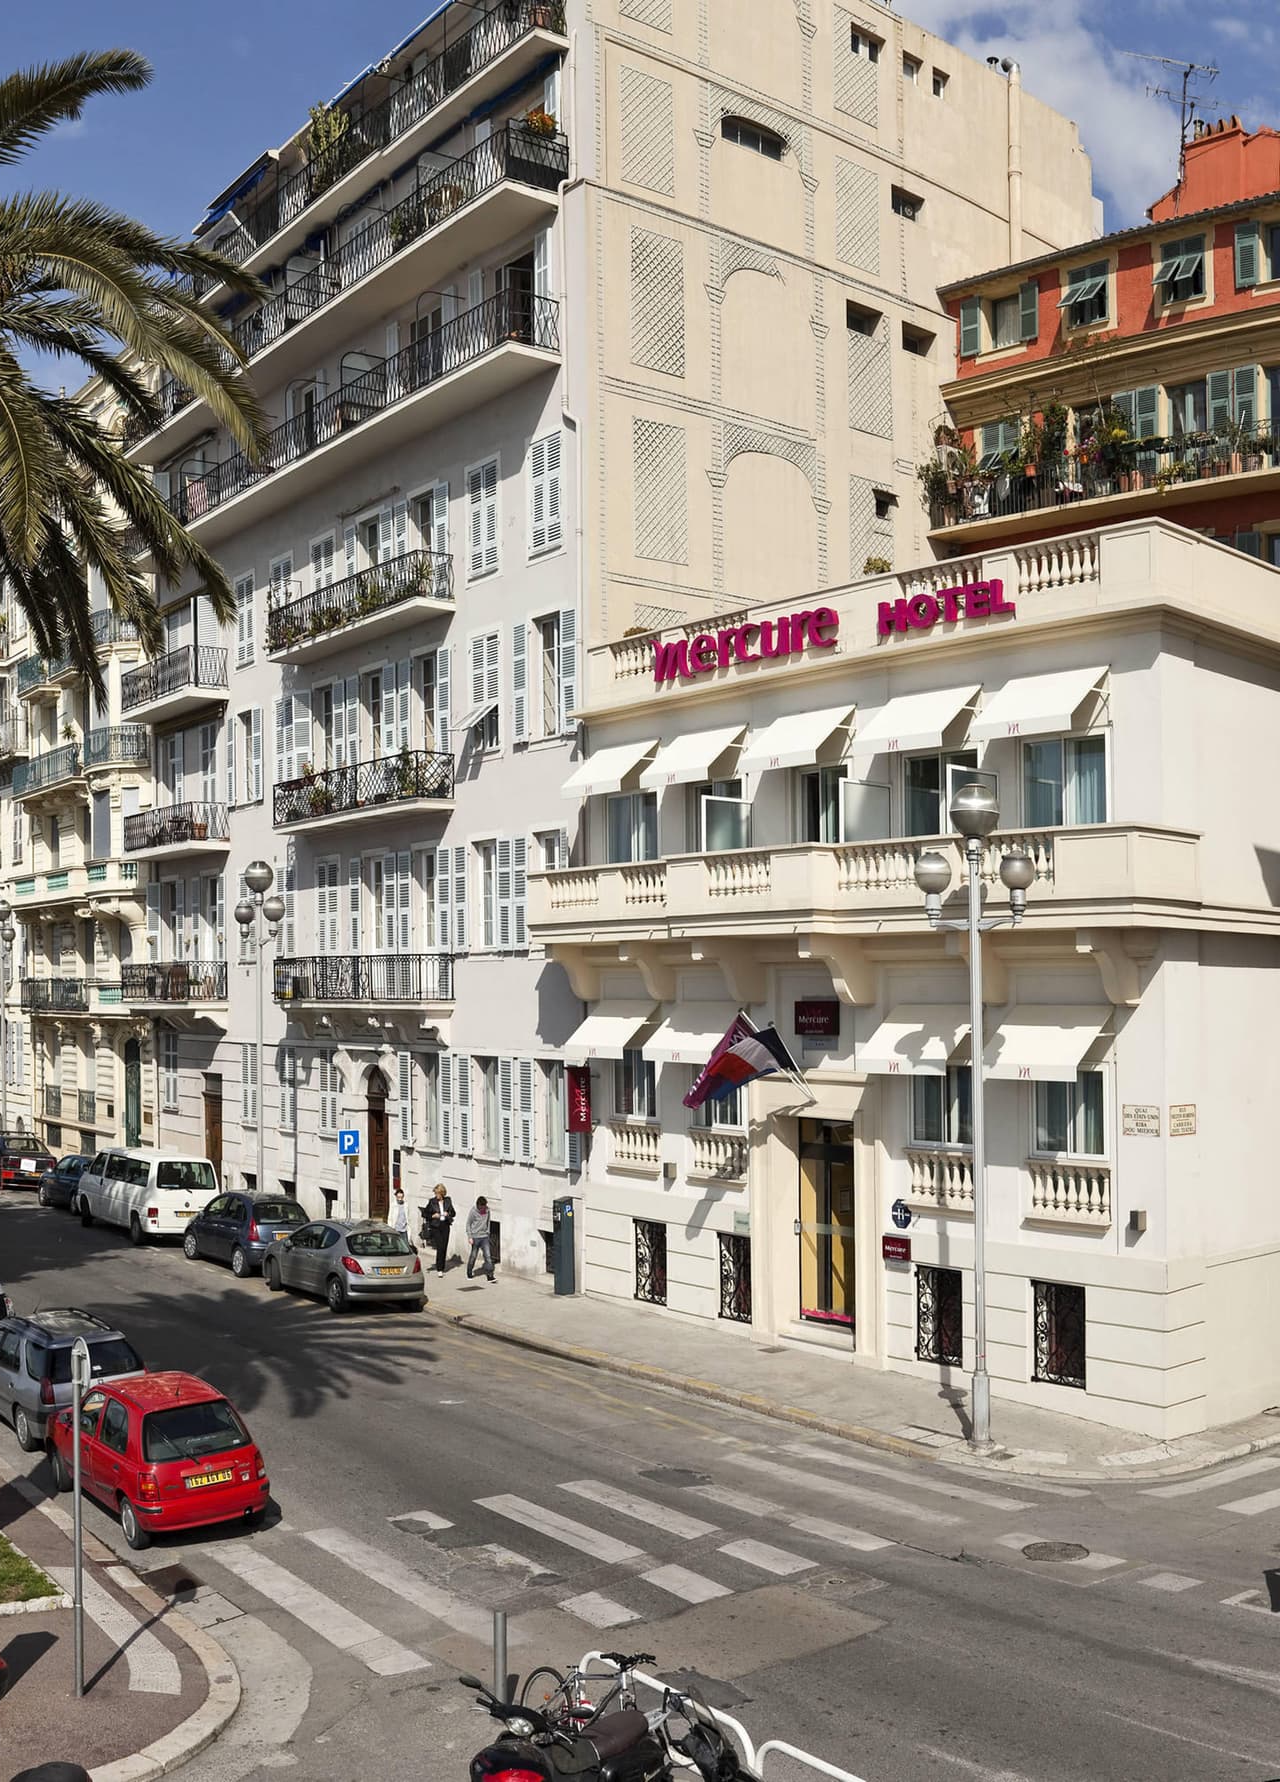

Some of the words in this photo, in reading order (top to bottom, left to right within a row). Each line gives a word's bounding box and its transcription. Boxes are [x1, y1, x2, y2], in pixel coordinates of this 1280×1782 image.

[878, 579, 1015, 635] HOTEL
[798, 1015, 831, 1024] Mercure
[344, 1134, 354, 1151] P
